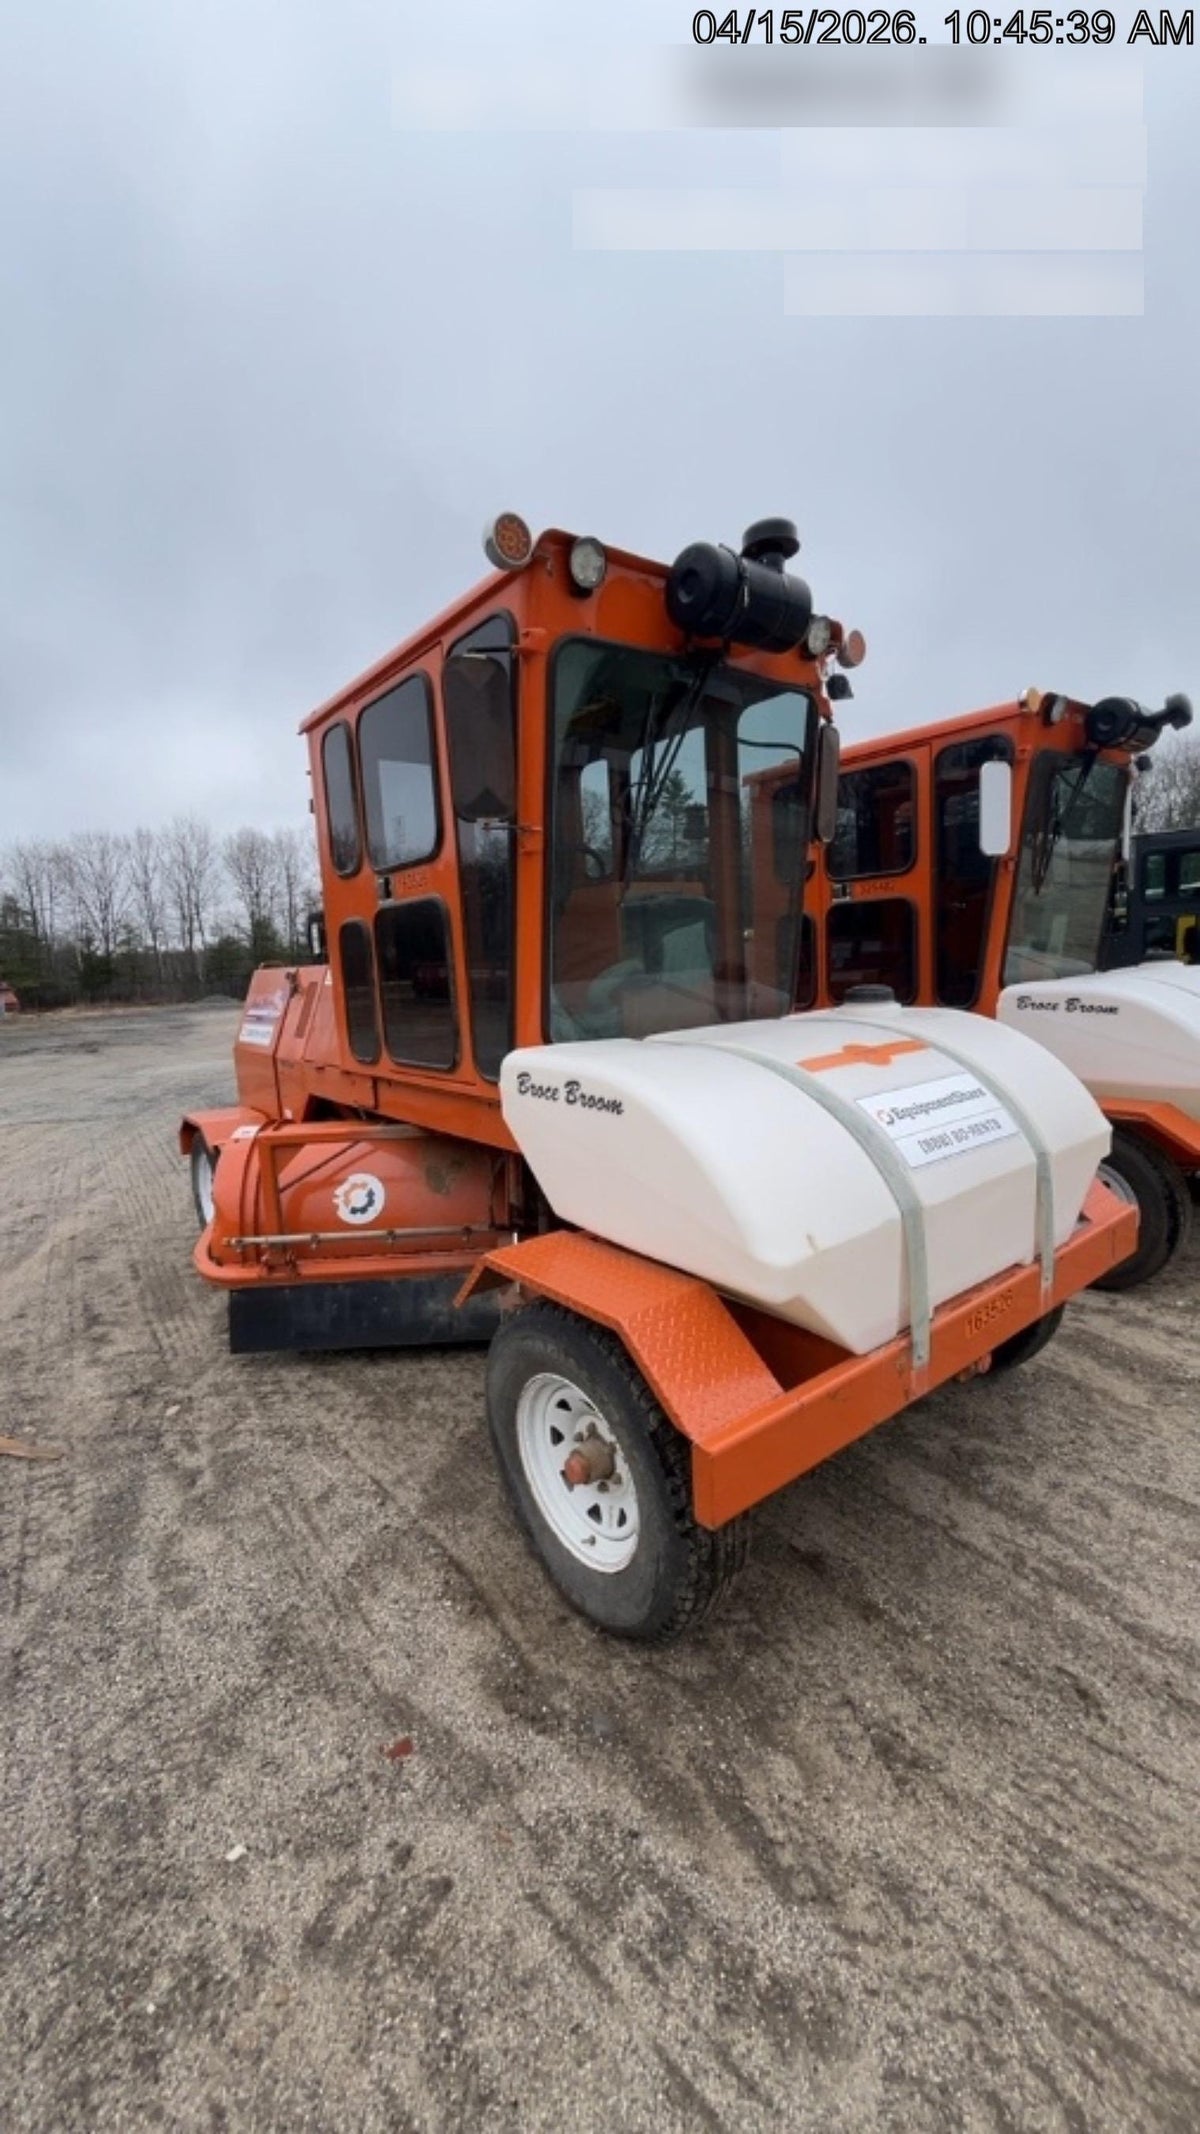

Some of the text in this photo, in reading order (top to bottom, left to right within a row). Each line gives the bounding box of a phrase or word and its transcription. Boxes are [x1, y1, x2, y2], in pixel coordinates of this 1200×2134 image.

[1016, 995, 1119, 1015] Broce Broom
[516, 1071, 624, 1115] Broce Broom
[890, 1087, 987, 1119] EquipmentShare
